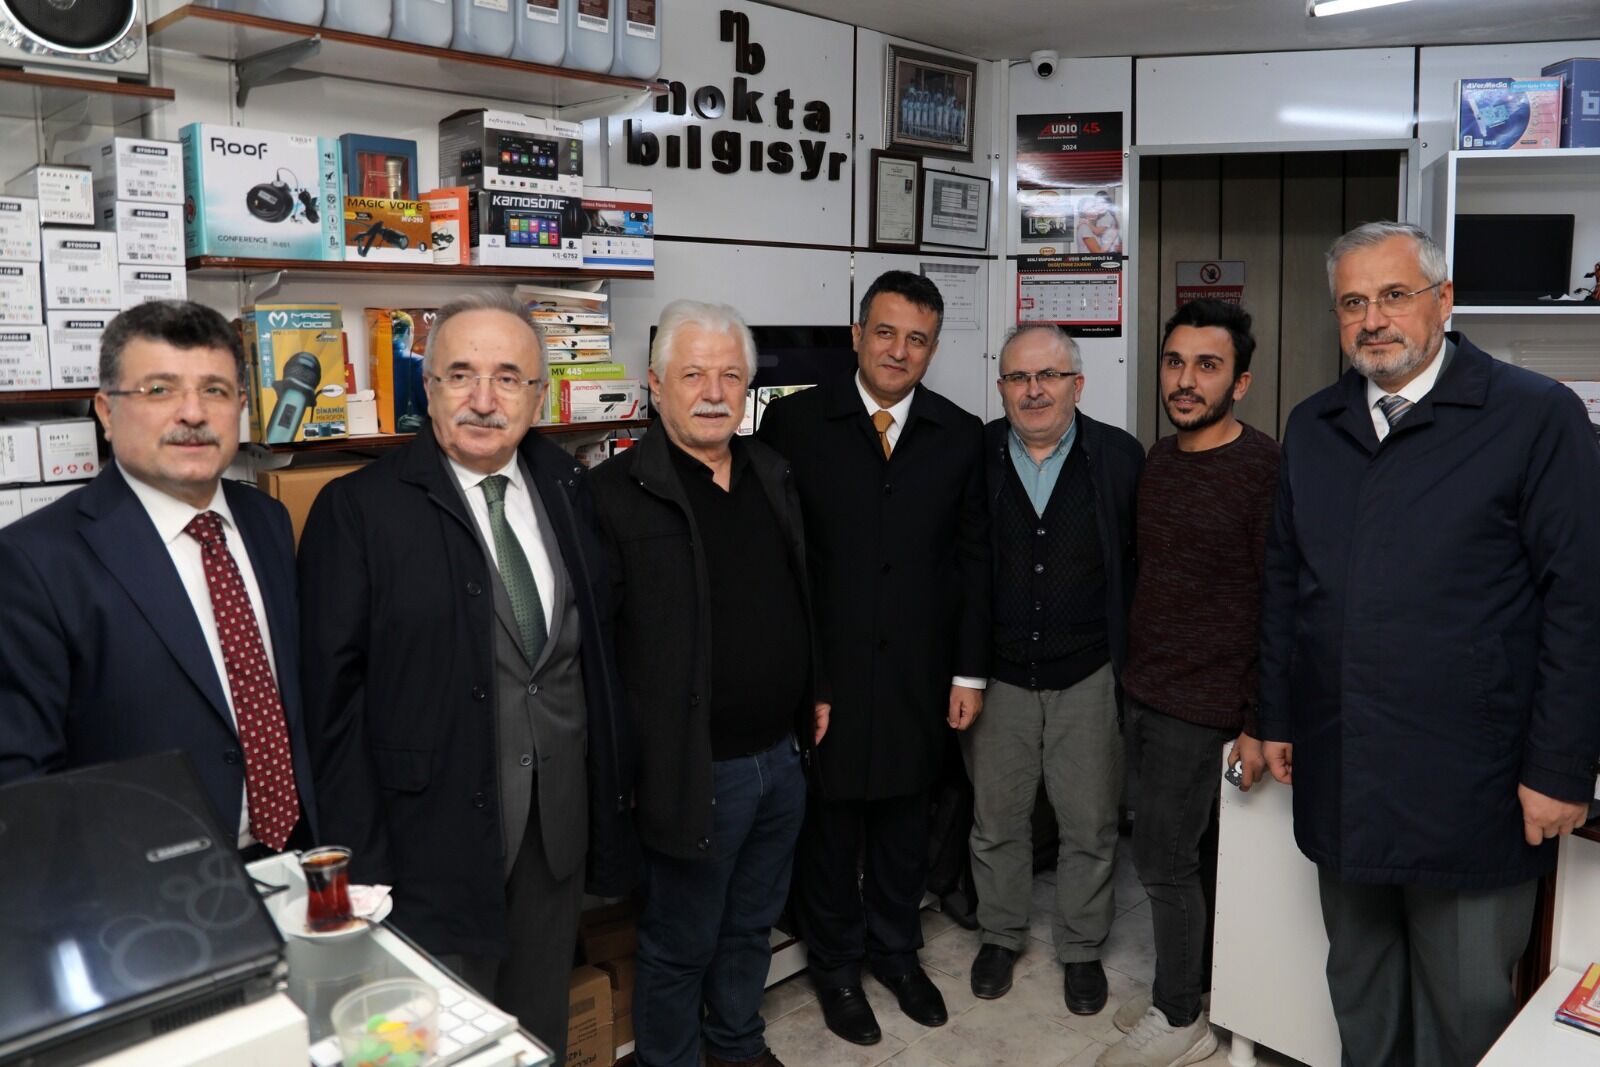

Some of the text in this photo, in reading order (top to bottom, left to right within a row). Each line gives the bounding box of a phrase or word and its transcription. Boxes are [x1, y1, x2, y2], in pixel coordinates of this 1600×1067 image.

[655, 77, 831, 133] nokta
[1040, 122, 1077, 136] AUDIO
[210, 137, 269, 160] Roof
[347, 198, 385, 209] MAGIC
[390, 200, 423, 212] VOICE
[217, 234, 268, 244] CONFERENCE
[551, 367, 565, 376] MV
[566, 367, 583, 376] 445
